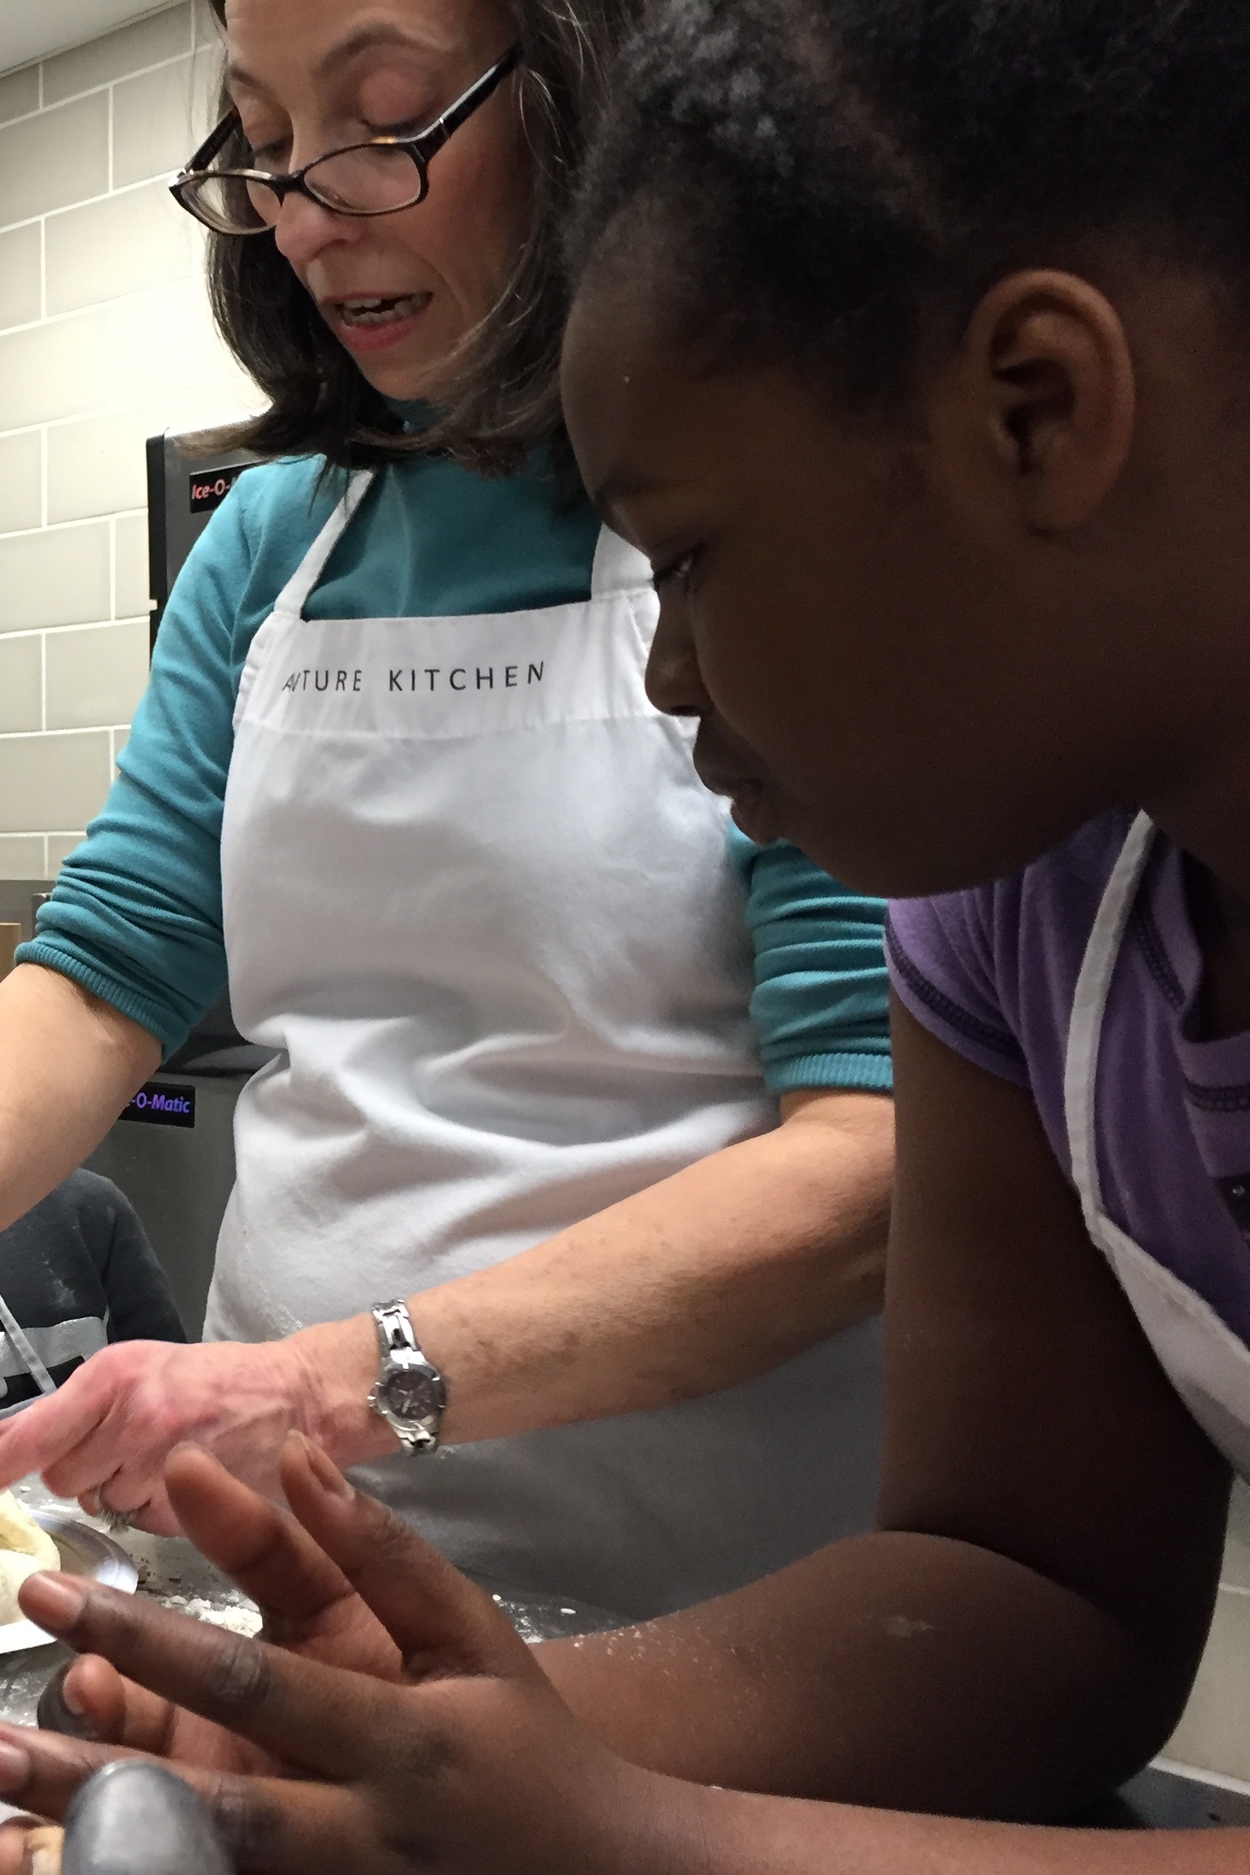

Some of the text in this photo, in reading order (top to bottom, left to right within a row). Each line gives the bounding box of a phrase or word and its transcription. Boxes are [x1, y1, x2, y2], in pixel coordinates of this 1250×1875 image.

[192, 478, 236, 500] Ice-O-
[388, 661, 545, 692] KITCHEN
[127, 1092, 191, 1114] -O-Matic
